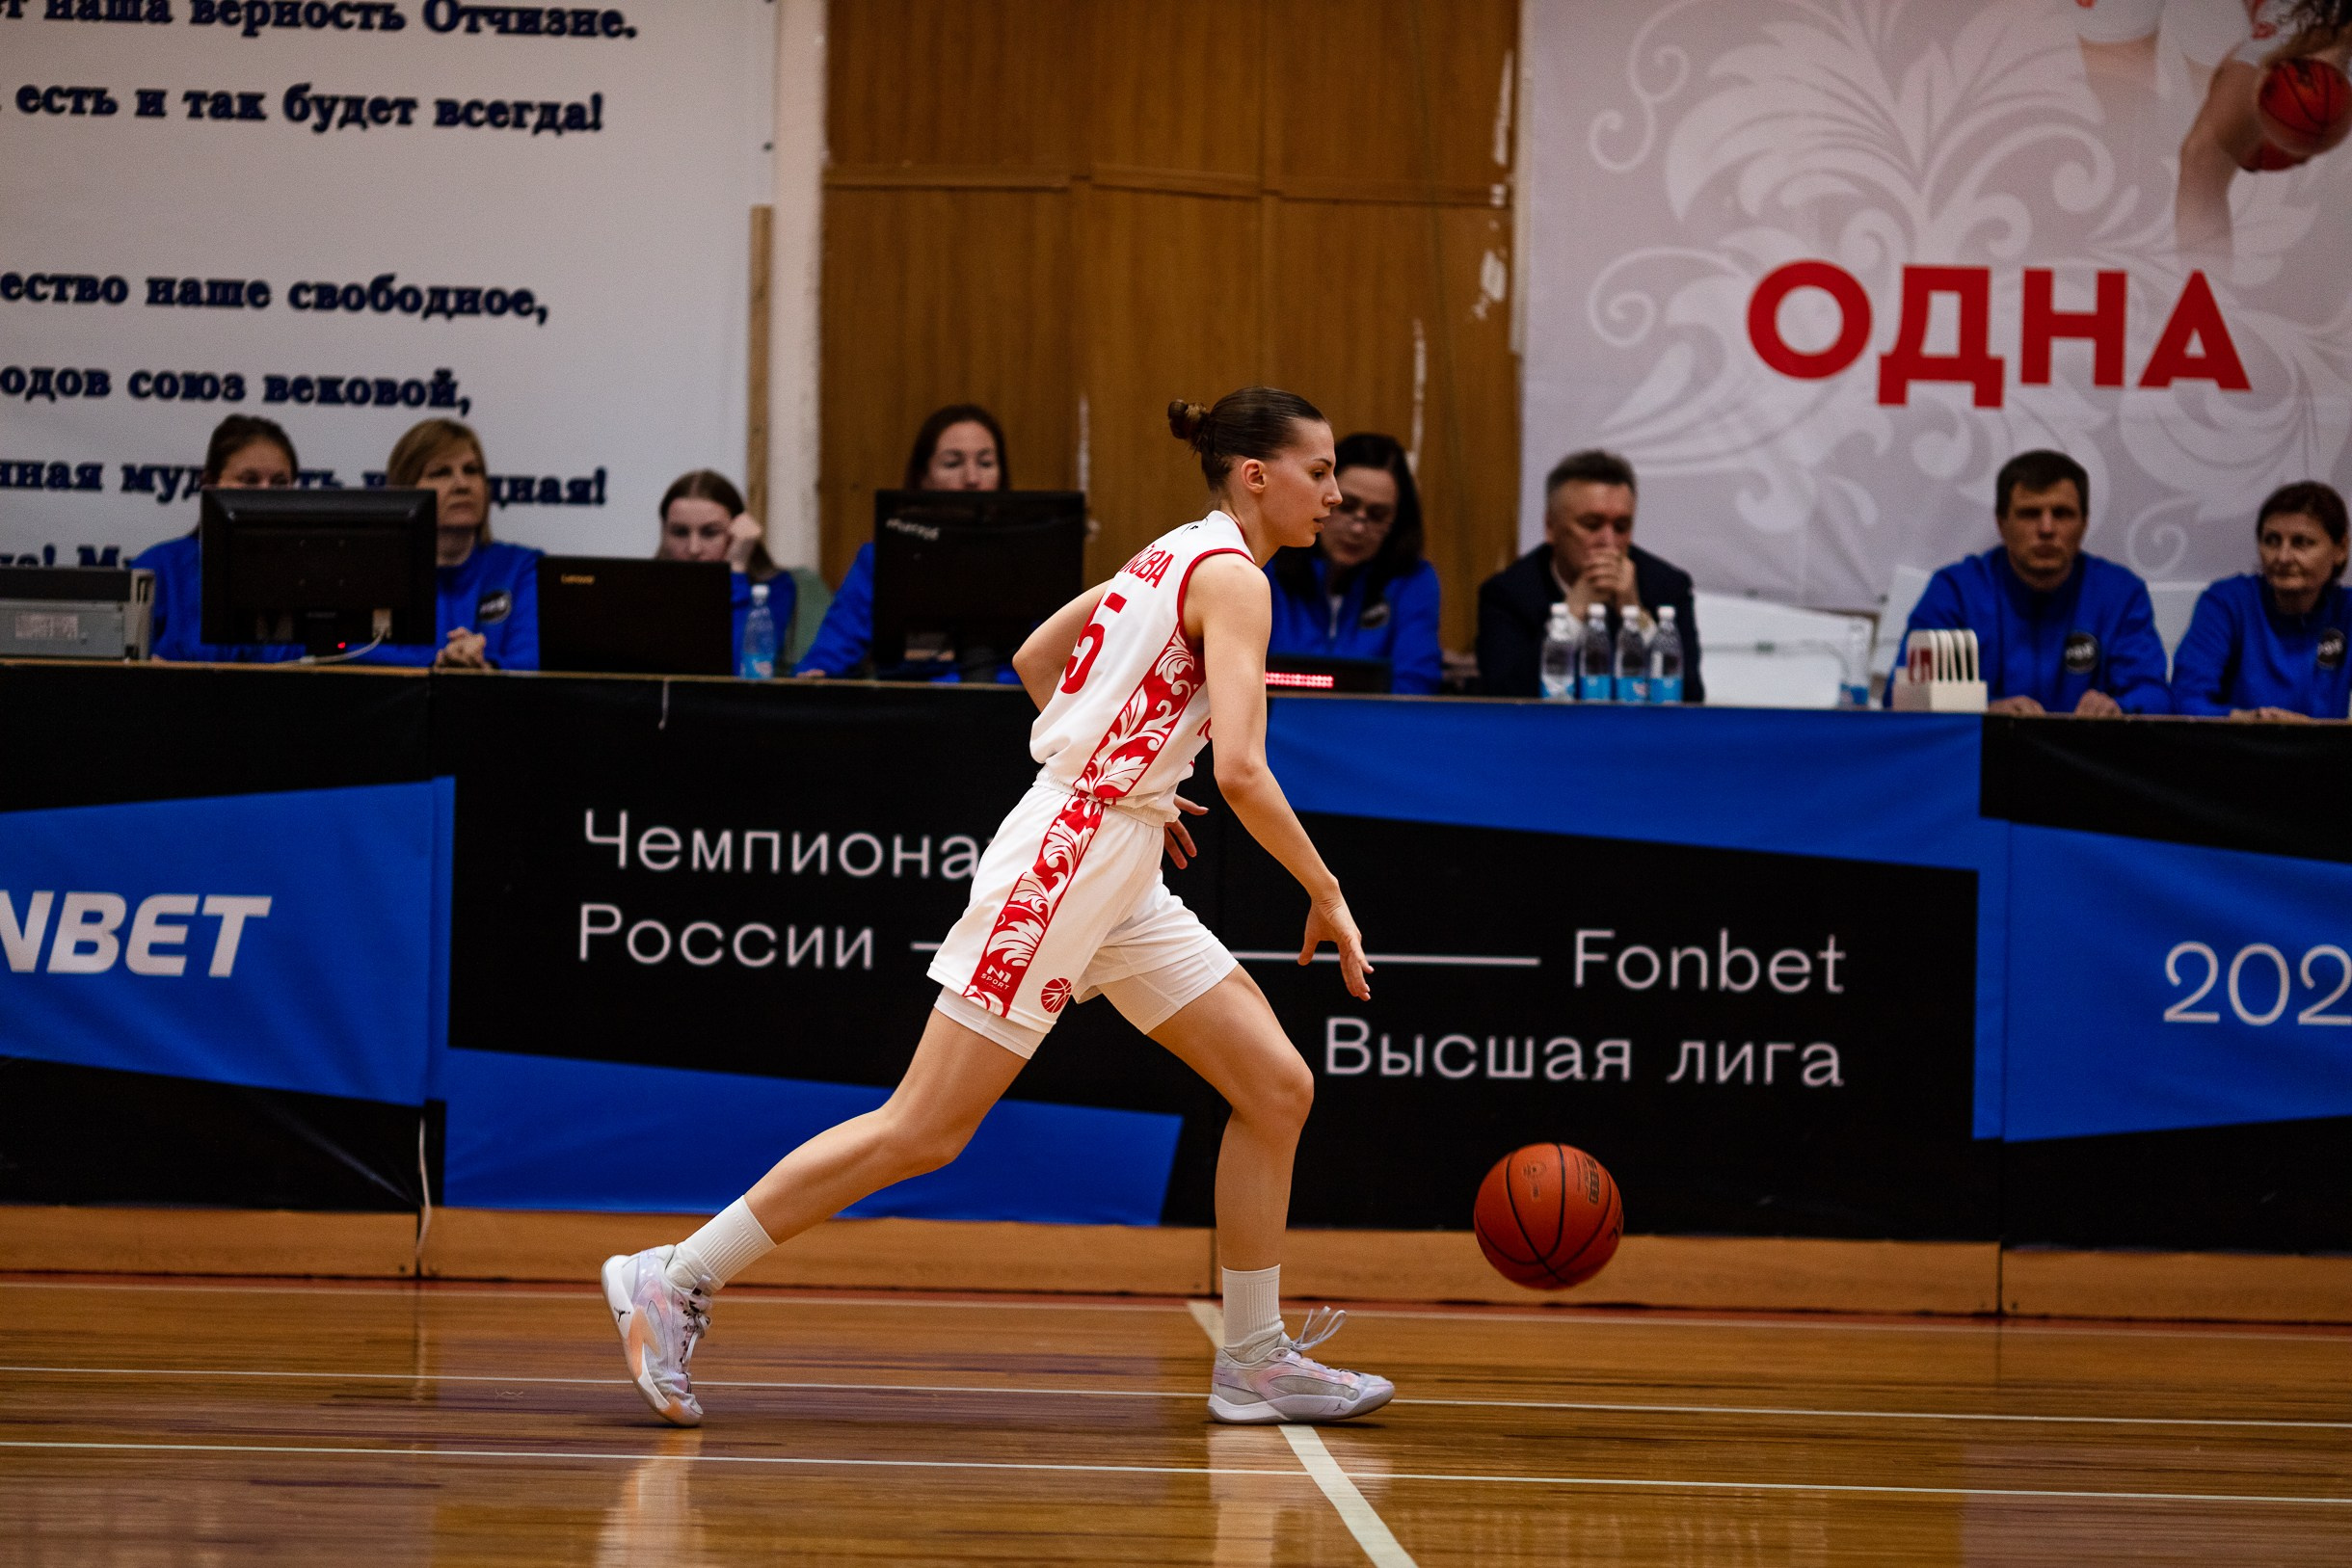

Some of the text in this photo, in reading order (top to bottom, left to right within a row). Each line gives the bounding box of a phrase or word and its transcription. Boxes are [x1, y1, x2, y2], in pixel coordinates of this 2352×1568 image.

[44, 0, 174, 23] наша
[190, 0, 406, 38] верность
[422, 0, 637, 39] Отчизне.
[15, 82, 603, 136] есть и так будет всегда!
[146, 276, 271, 309] наше
[288, 273, 548, 327] свободное,
[1747, 258, 2252, 409] ОДНА
[0, 365, 471, 417] одов союз вековой,
[583, 808, 995, 880] Чемпиона
[0, 889, 273, 978] NBET
[578, 902, 874, 969] России
[1574, 927, 1847, 994] Fonbet
[980, 972, 1010, 990] SPORT
[2163, 941, 2352, 1026] 202
[1324, 1016, 1845, 1087] Высшая лига
